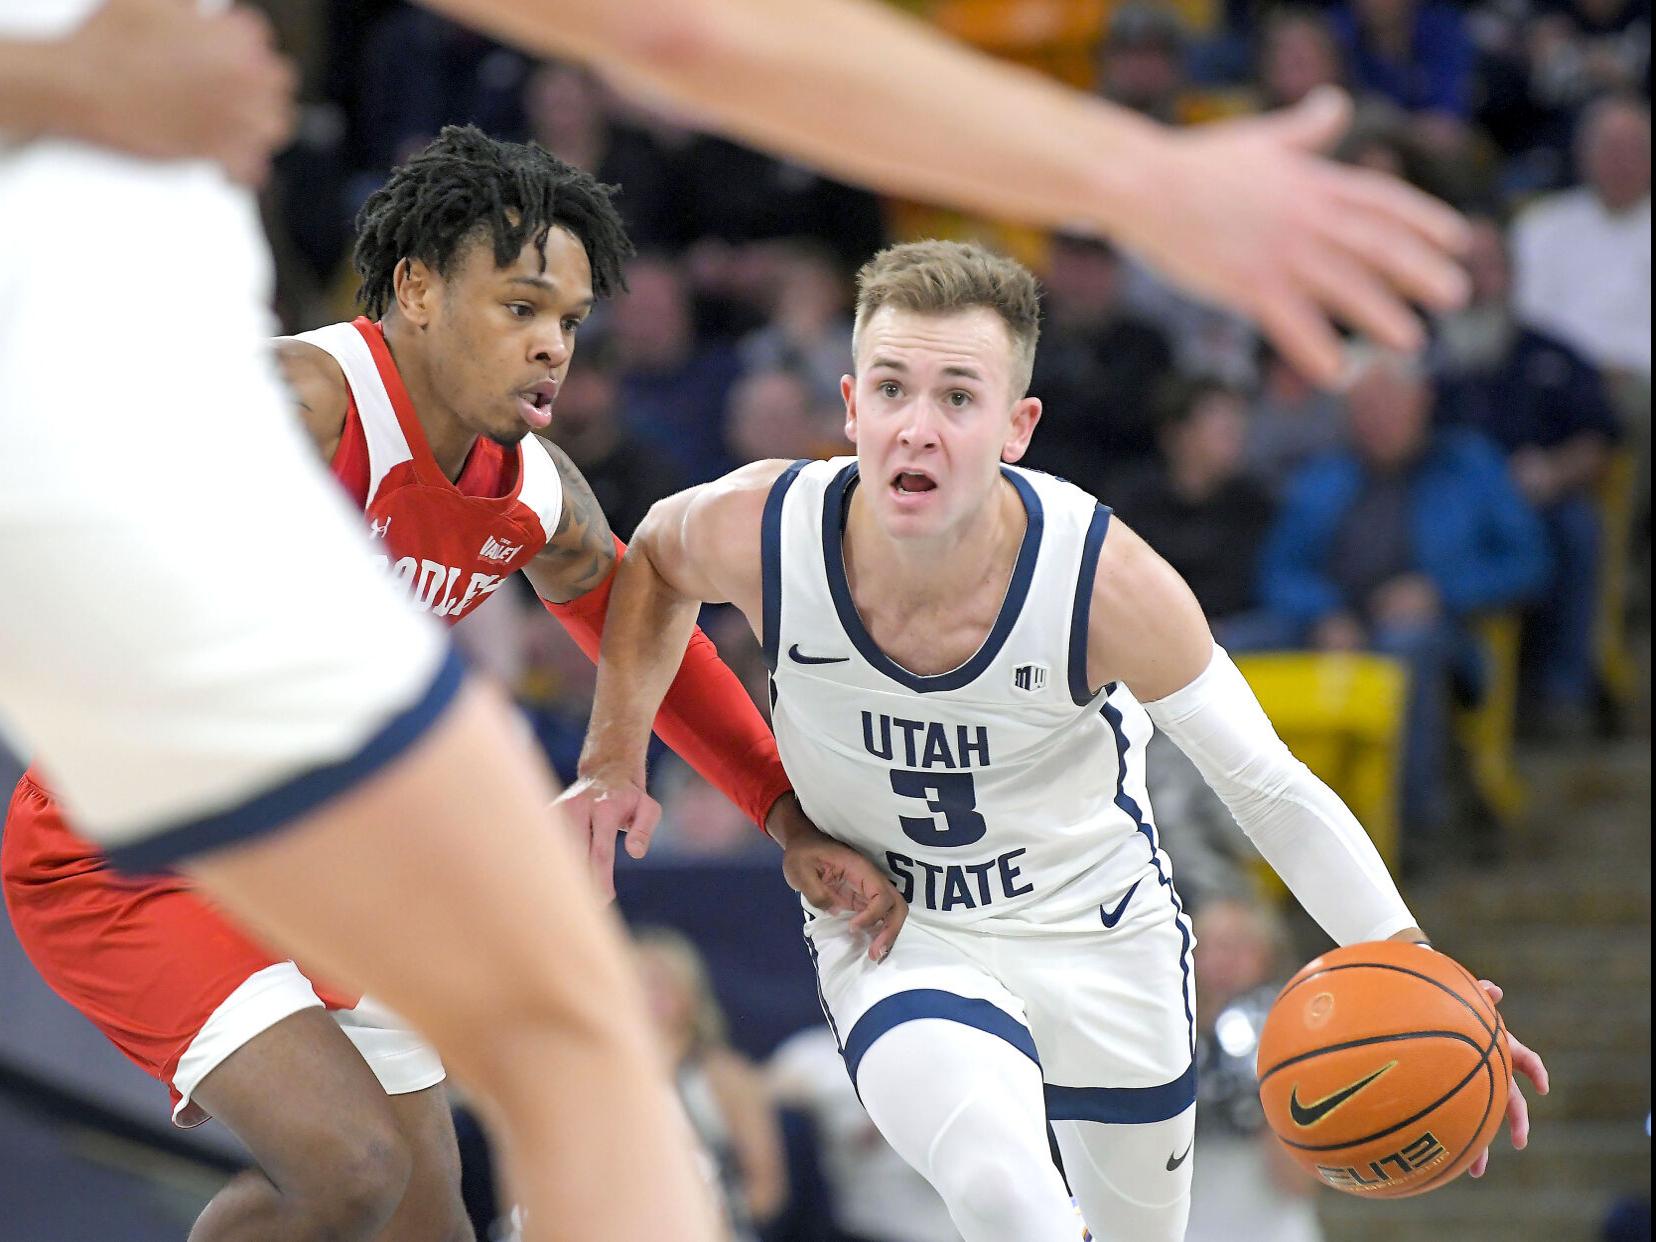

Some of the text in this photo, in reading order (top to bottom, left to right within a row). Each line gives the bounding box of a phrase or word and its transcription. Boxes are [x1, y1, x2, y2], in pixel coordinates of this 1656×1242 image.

[861, 711, 990, 769] UTAH
[889, 768, 987, 848] 3
[886, 847, 1034, 912] STATE
